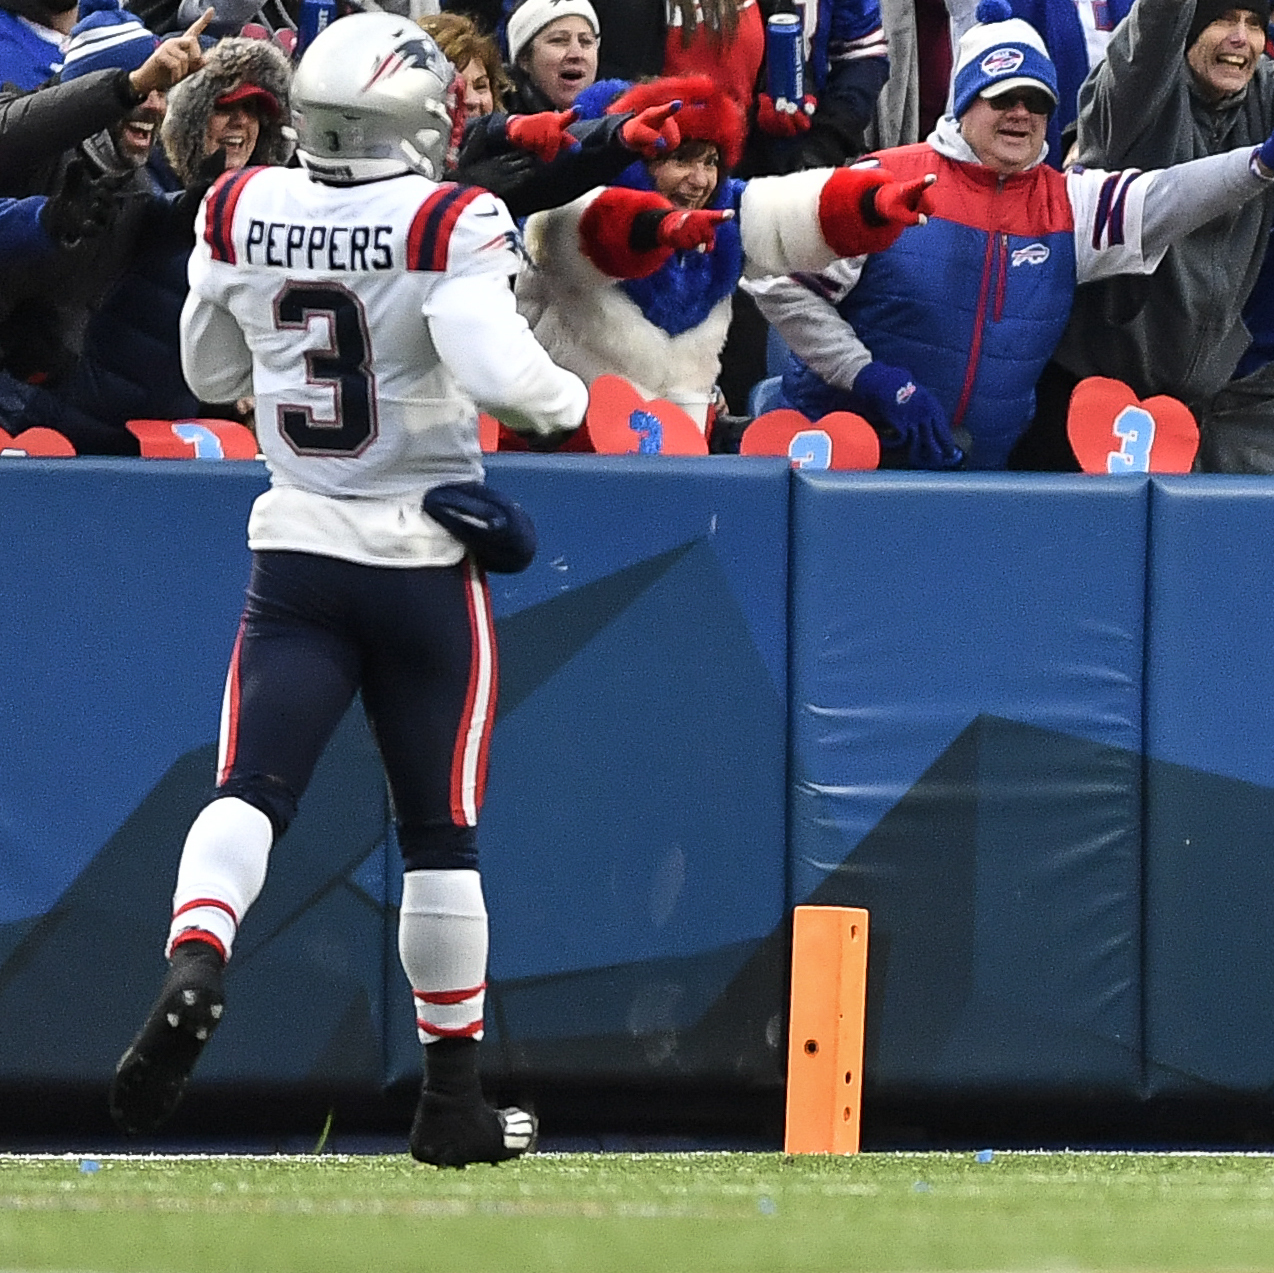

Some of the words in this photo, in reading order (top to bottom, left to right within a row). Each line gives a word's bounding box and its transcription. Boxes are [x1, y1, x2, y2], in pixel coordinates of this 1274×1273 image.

[245, 219, 396, 271] PEPPERS
[275, 280, 379, 457] 3
[1107, 406, 1154, 475] 3
